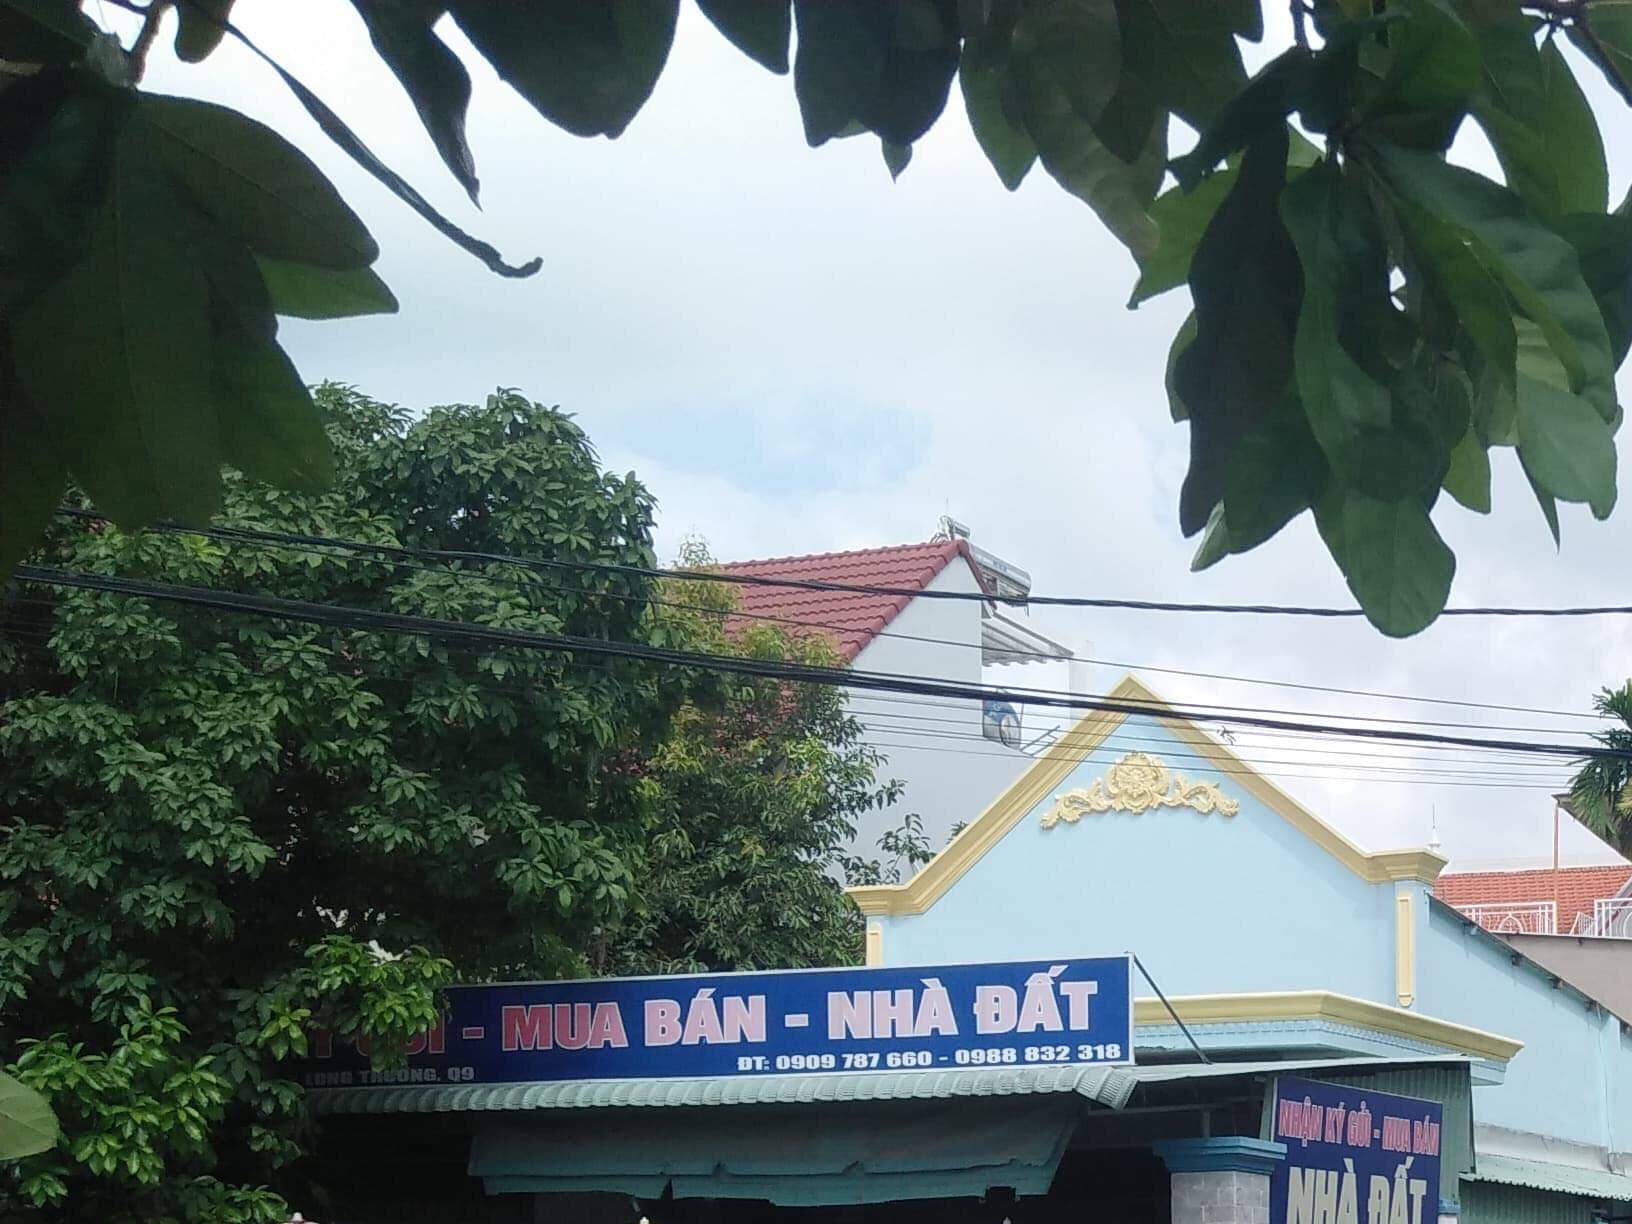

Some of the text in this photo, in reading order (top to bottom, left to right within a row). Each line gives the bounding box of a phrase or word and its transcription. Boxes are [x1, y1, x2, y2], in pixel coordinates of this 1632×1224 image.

[502, 1001, 628, 1052] MUA
[644, 988, 767, 1047] BÁN
[828, 978, 959, 1040] NHÀ
[973, 965, 1098, 1035] ĐẤT
[447, 1065, 475, 1082] Q9
[775, 1054, 836, 1070] 0909
[841, 1052, 880, 1068] 787
[886, 1051, 932, 1067] 660
[955, 1048, 1017, 1064] 0988
[1024, 1046, 1070, 1062] 832
[1077, 1043, 1121, 1060] 318
[1278, 1095, 1323, 1147] NHẬN
[1413, 1115, 1440, 1156] BÁN
